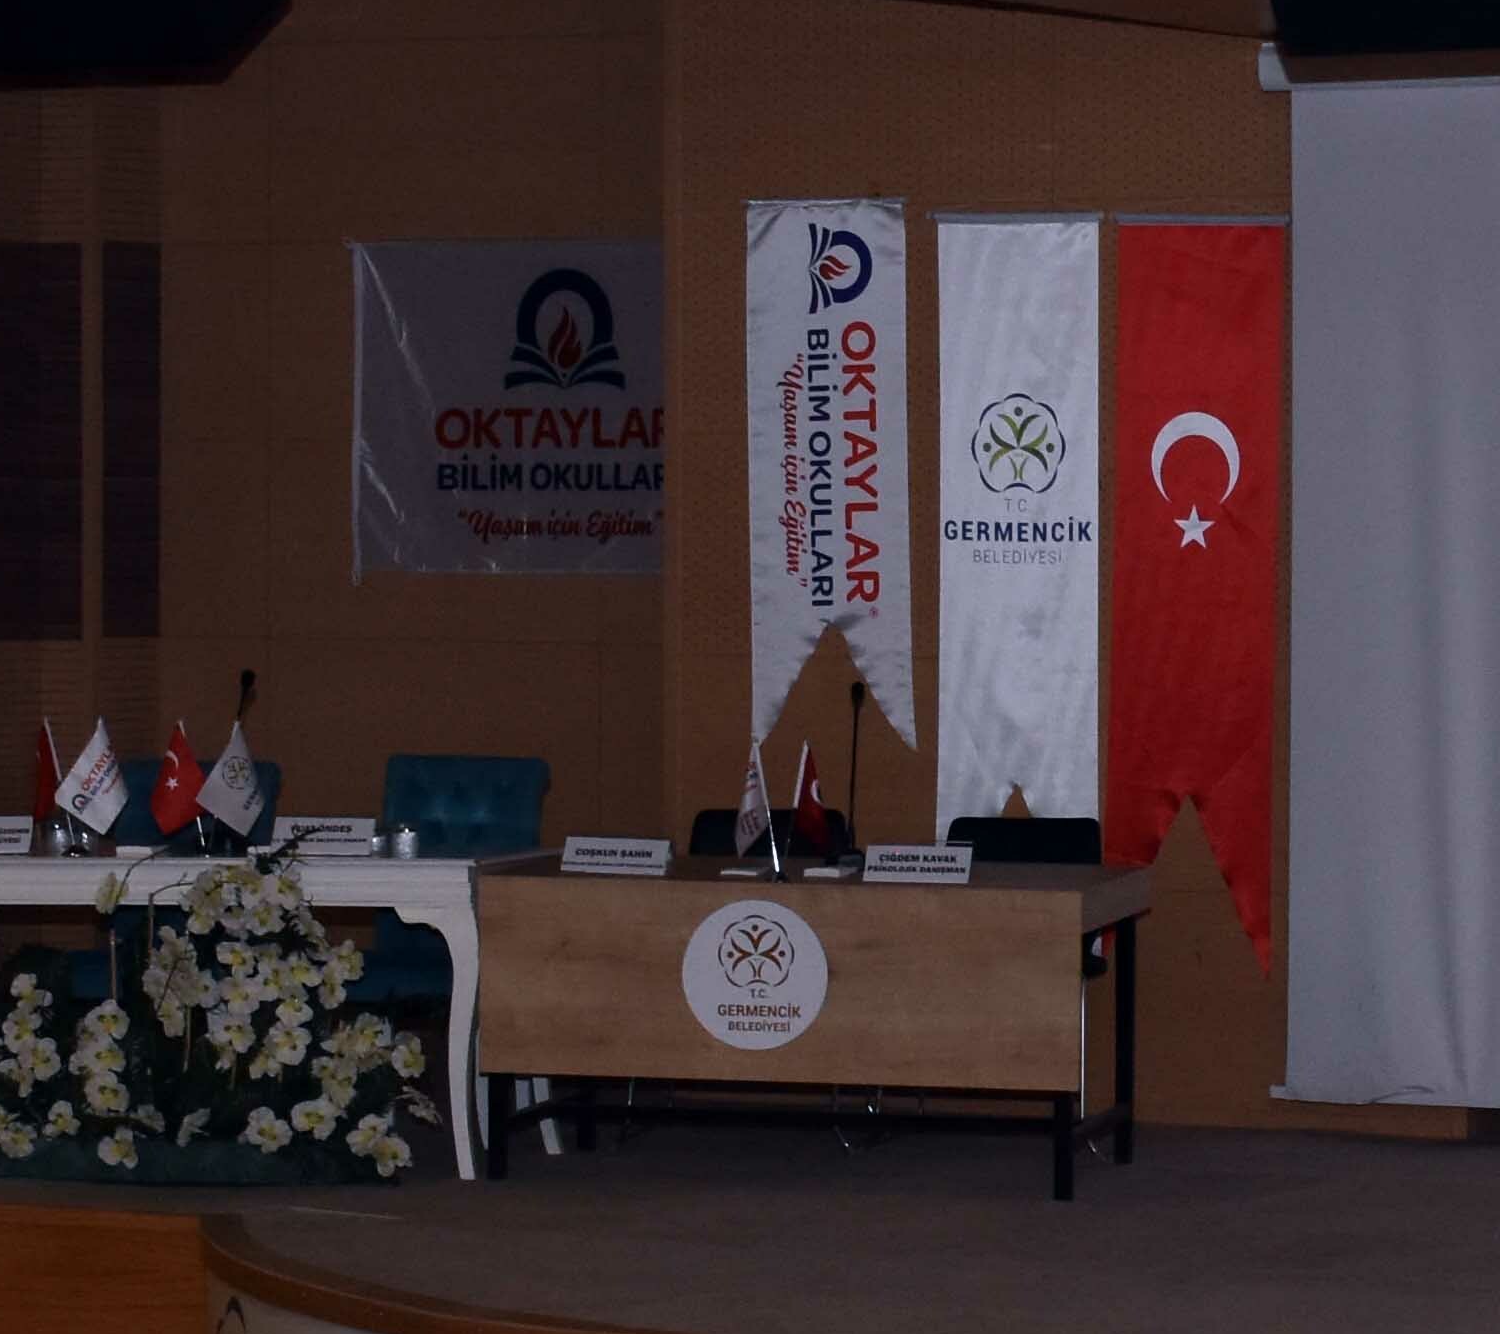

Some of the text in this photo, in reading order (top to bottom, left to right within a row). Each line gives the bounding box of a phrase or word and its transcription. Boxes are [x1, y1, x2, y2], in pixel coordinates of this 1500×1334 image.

[436, 453, 523, 491] BİLİM
[807, 328, 839, 608] BİLİM OKULLARI
[841, 320, 880, 604] OKTAYLAR
[944, 516, 1092, 543] GERMENCİK
[973, 548, 1063, 565] BELEDİYESİ
[717, 1003, 801, 1018] GERMENCİK
[728, 1019, 791, 1032] BELEDİYESİ
